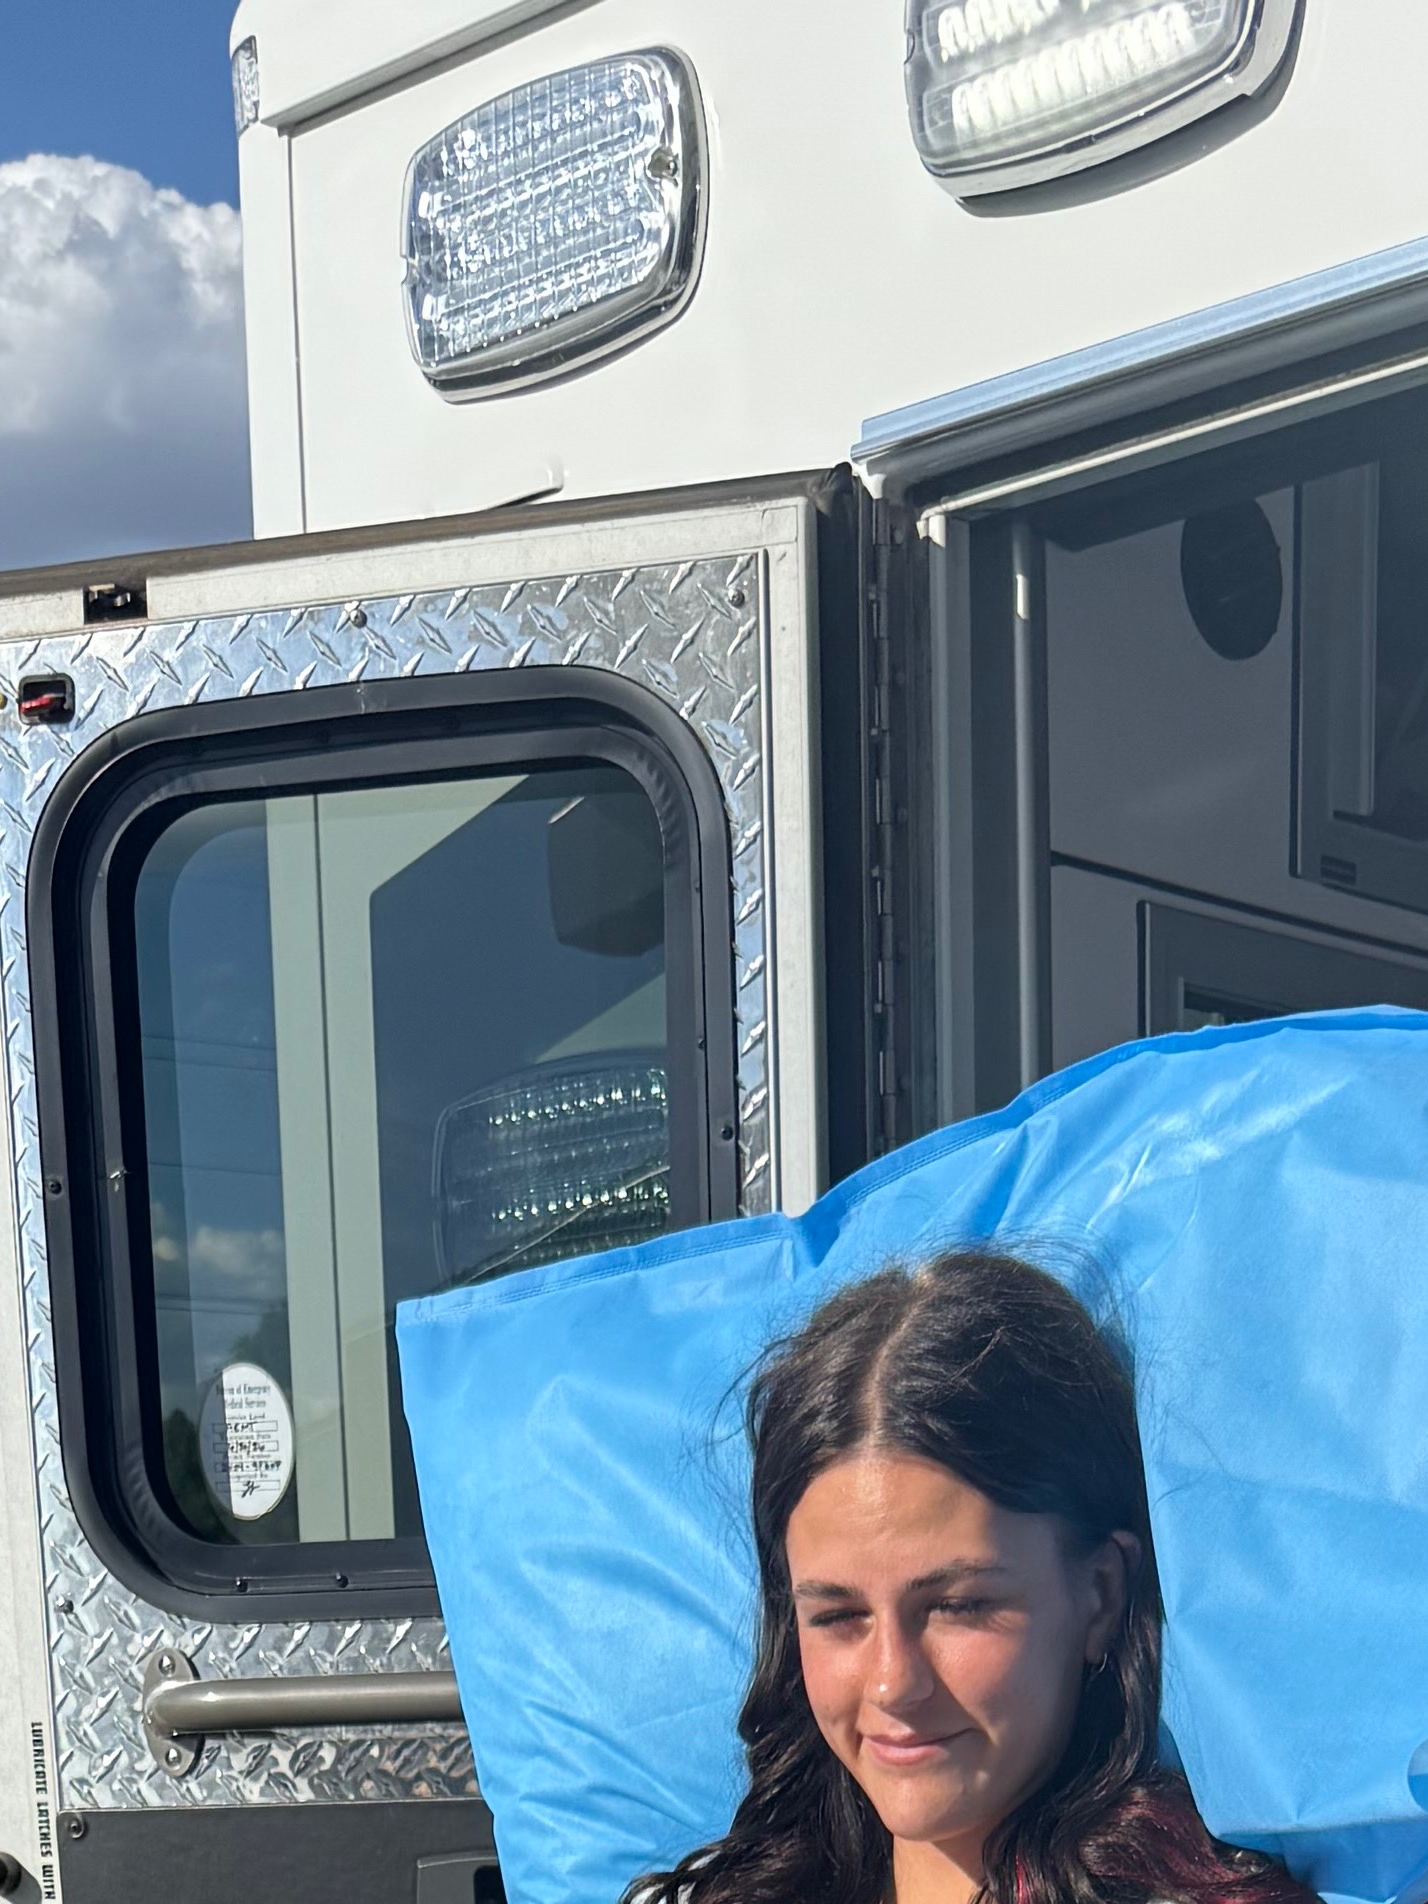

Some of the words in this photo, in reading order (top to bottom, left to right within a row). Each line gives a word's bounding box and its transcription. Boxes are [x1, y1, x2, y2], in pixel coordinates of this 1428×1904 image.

[31, 1721, 48, 1795] LUBRICATE
[37, 1802, 53, 1857] LATCHES
[42, 1864, 56, 1899] WITH
